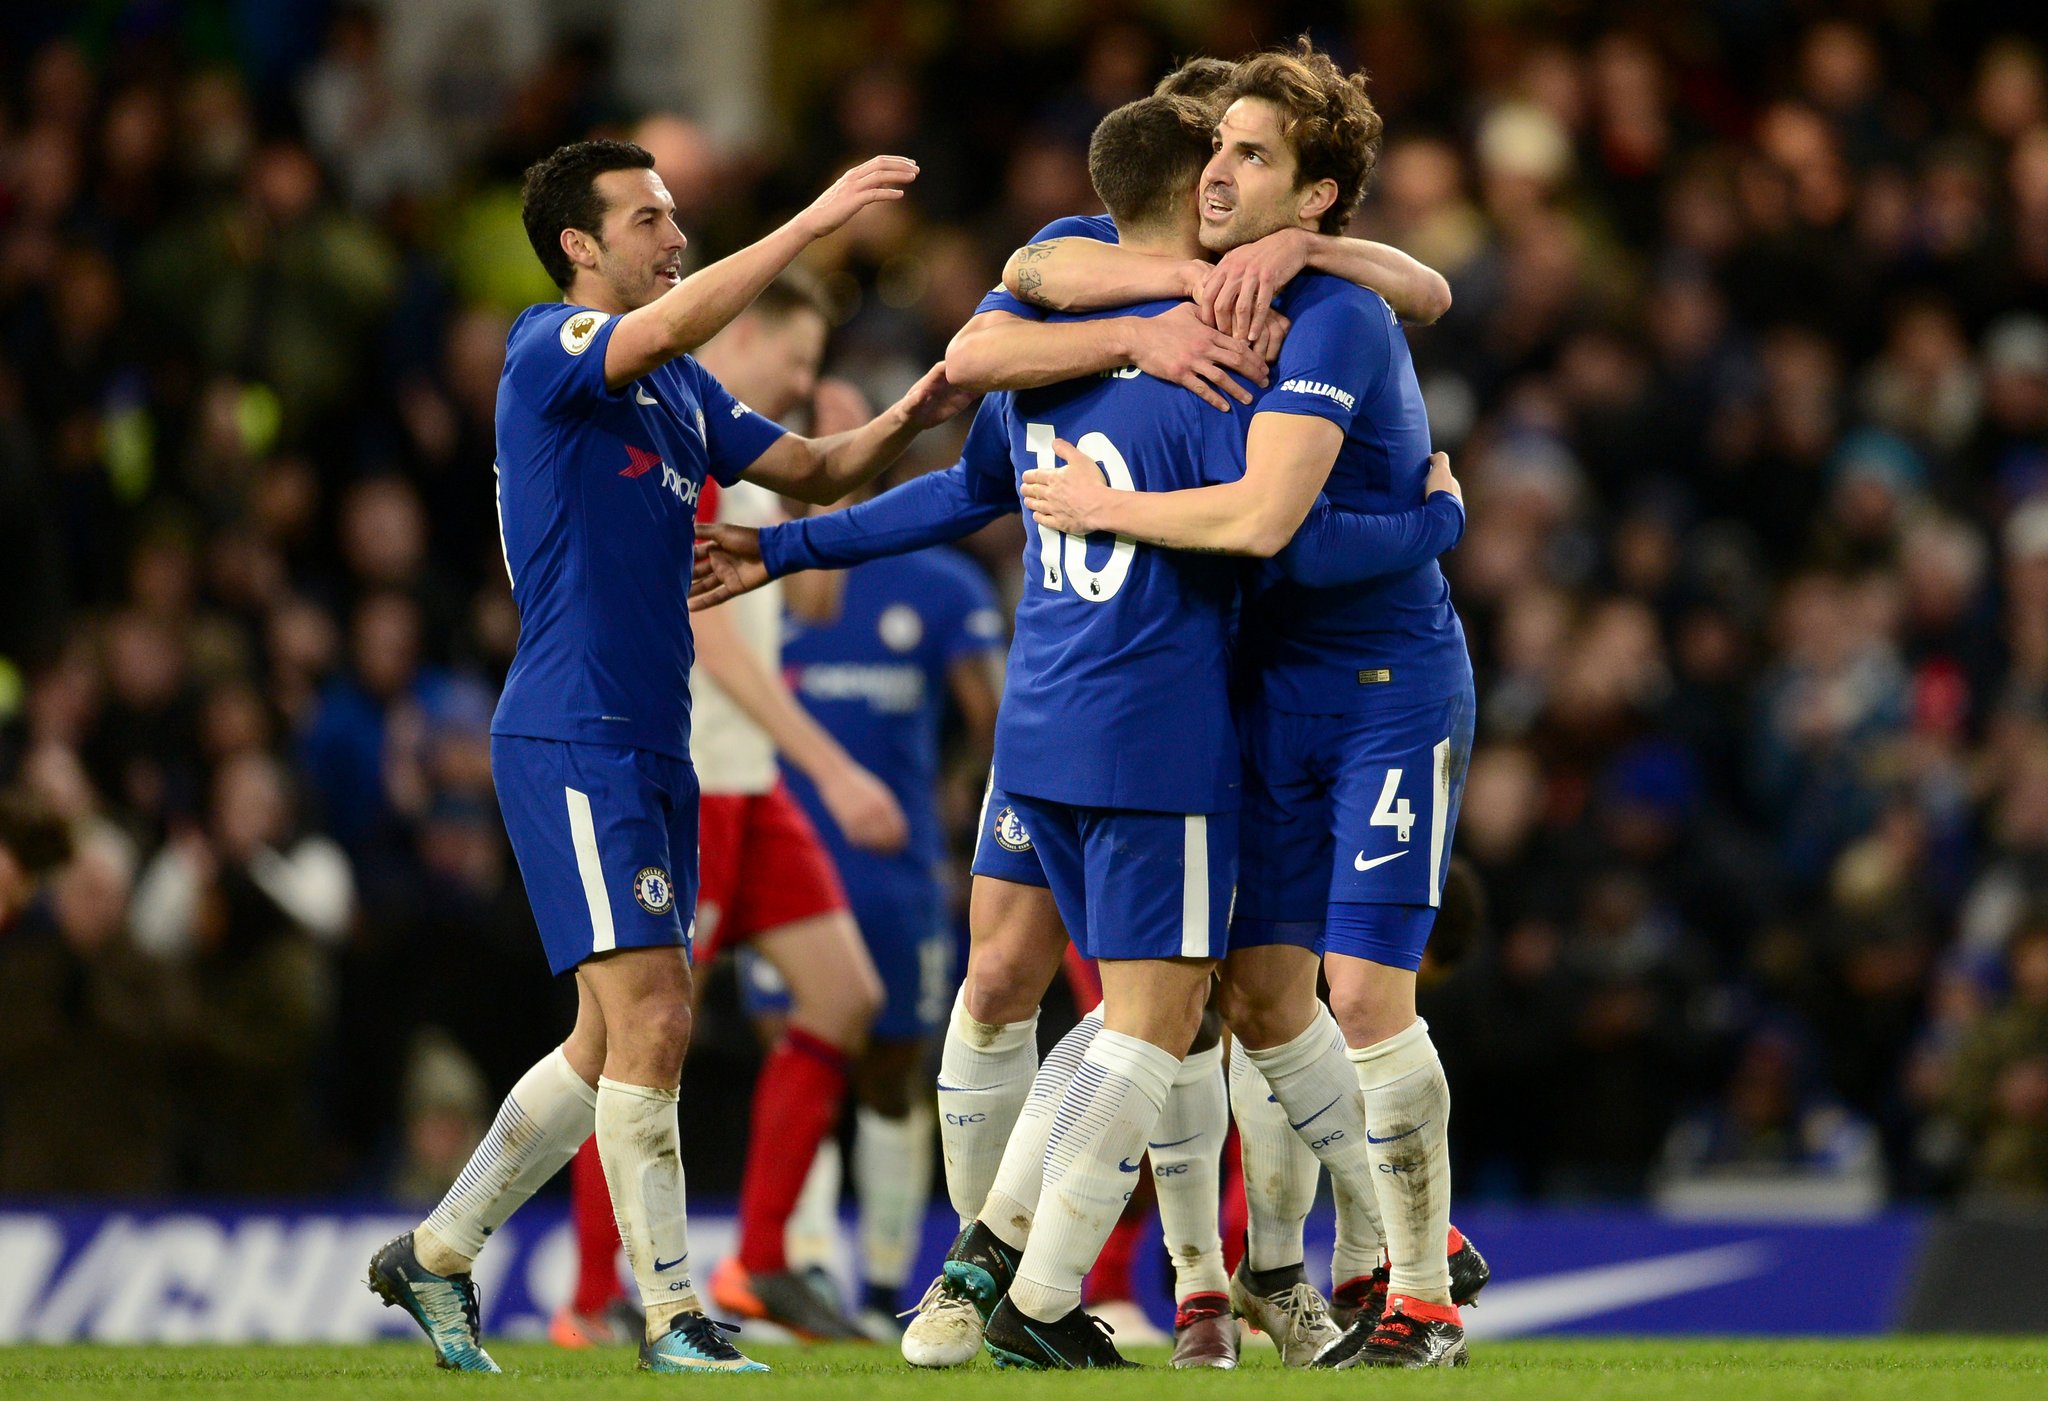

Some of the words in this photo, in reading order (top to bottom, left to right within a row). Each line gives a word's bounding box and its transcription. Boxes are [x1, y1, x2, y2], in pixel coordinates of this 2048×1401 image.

[1026, 422, 1136, 602] 10
[1370, 769, 1416, 842] 4
[639, 869, 665, 880] CHELSEA
[945, 1113, 986, 1127] CFC
[1312, 1130, 1344, 1149] CFC
[1155, 1164, 1188, 1177] CFC
[1379, 1162, 1418, 1175] CFC
[669, 1279, 691, 1291] CFC
